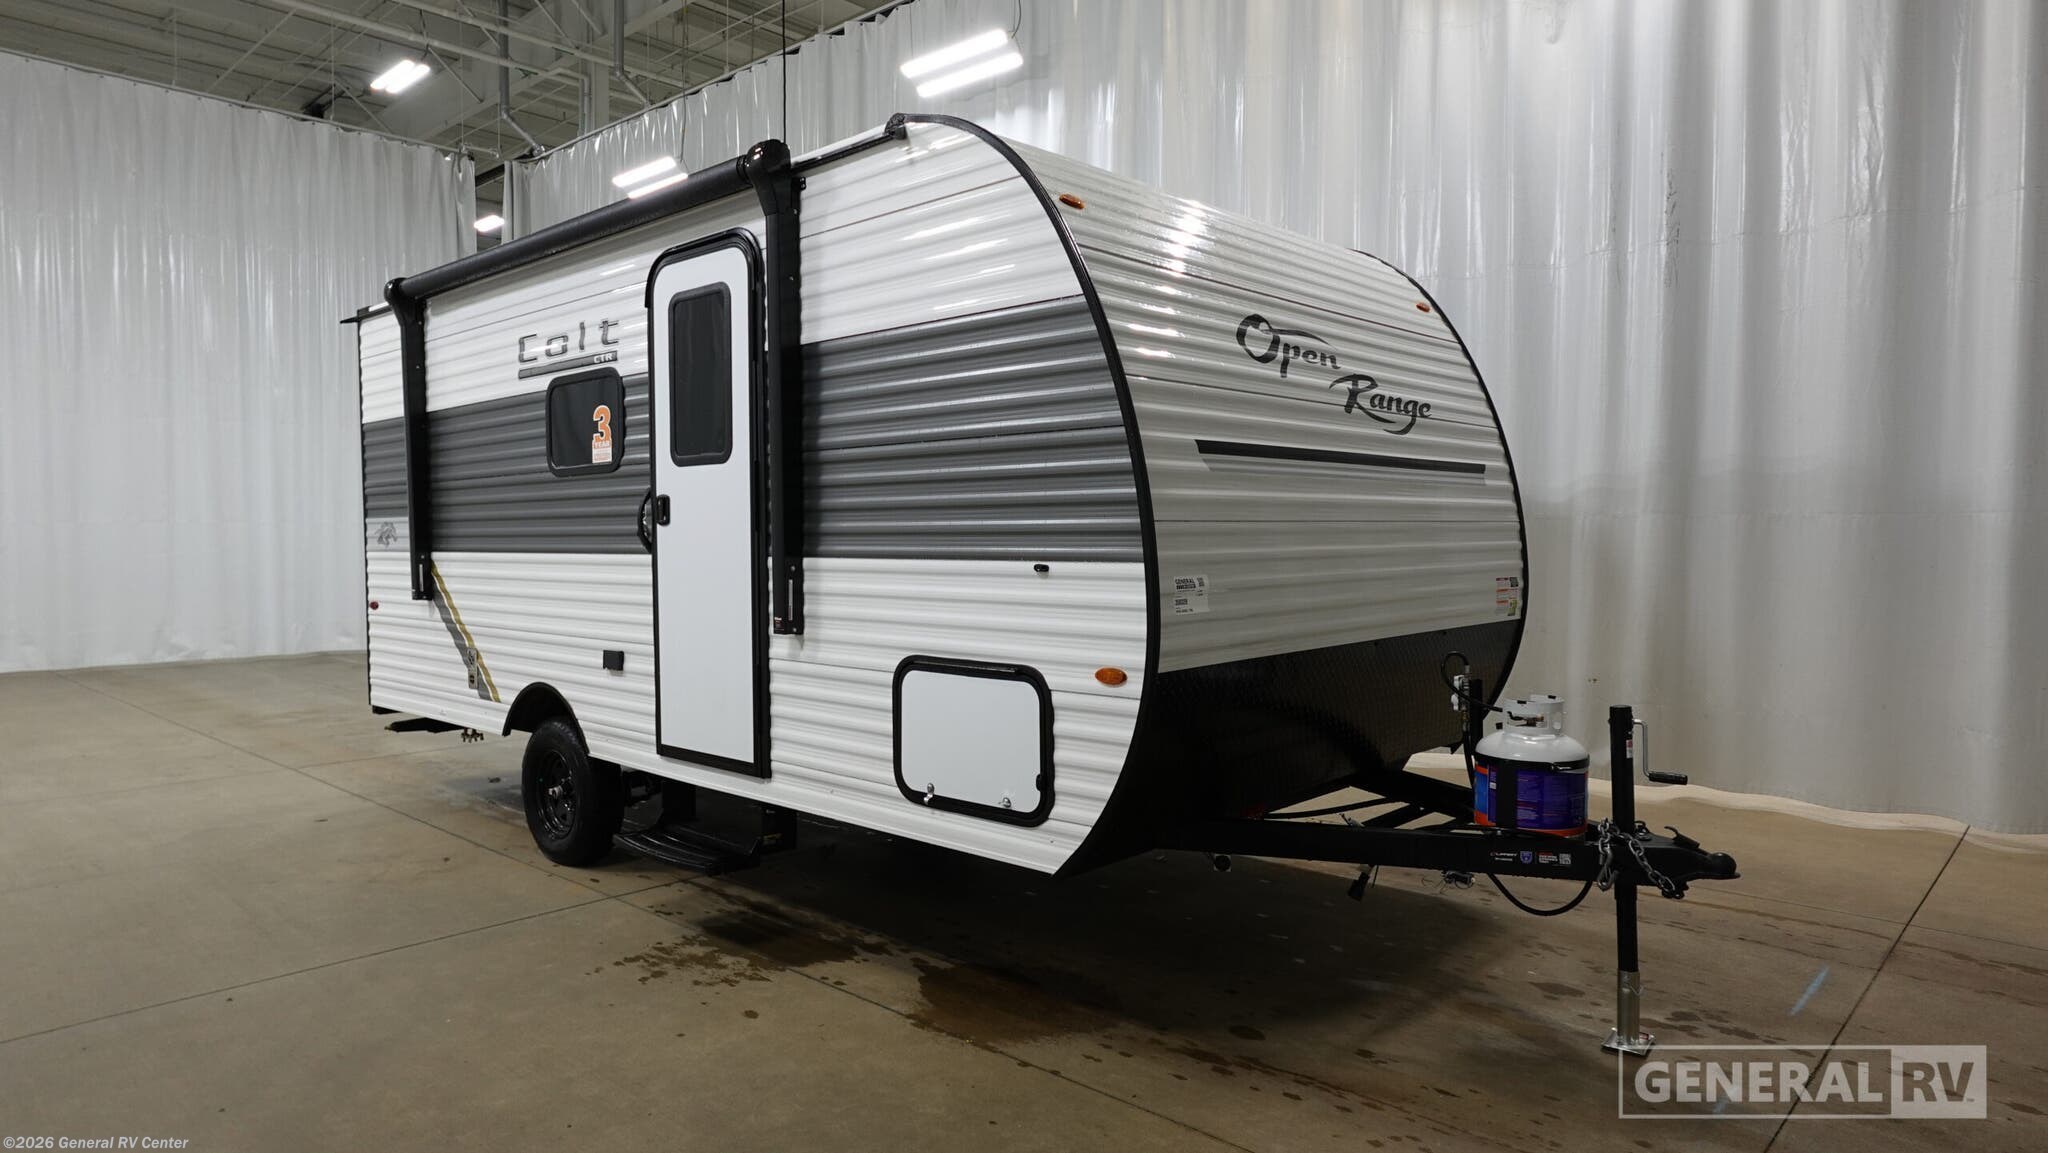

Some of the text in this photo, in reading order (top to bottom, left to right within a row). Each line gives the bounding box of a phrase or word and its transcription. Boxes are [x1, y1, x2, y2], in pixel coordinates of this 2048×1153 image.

[518, 319, 619, 363] Colt
[593, 353, 613, 364] CTR
[1236, 313, 1341, 378] Open
[593, 404, 611, 443] 3
[1328, 373, 1433, 435] Range
